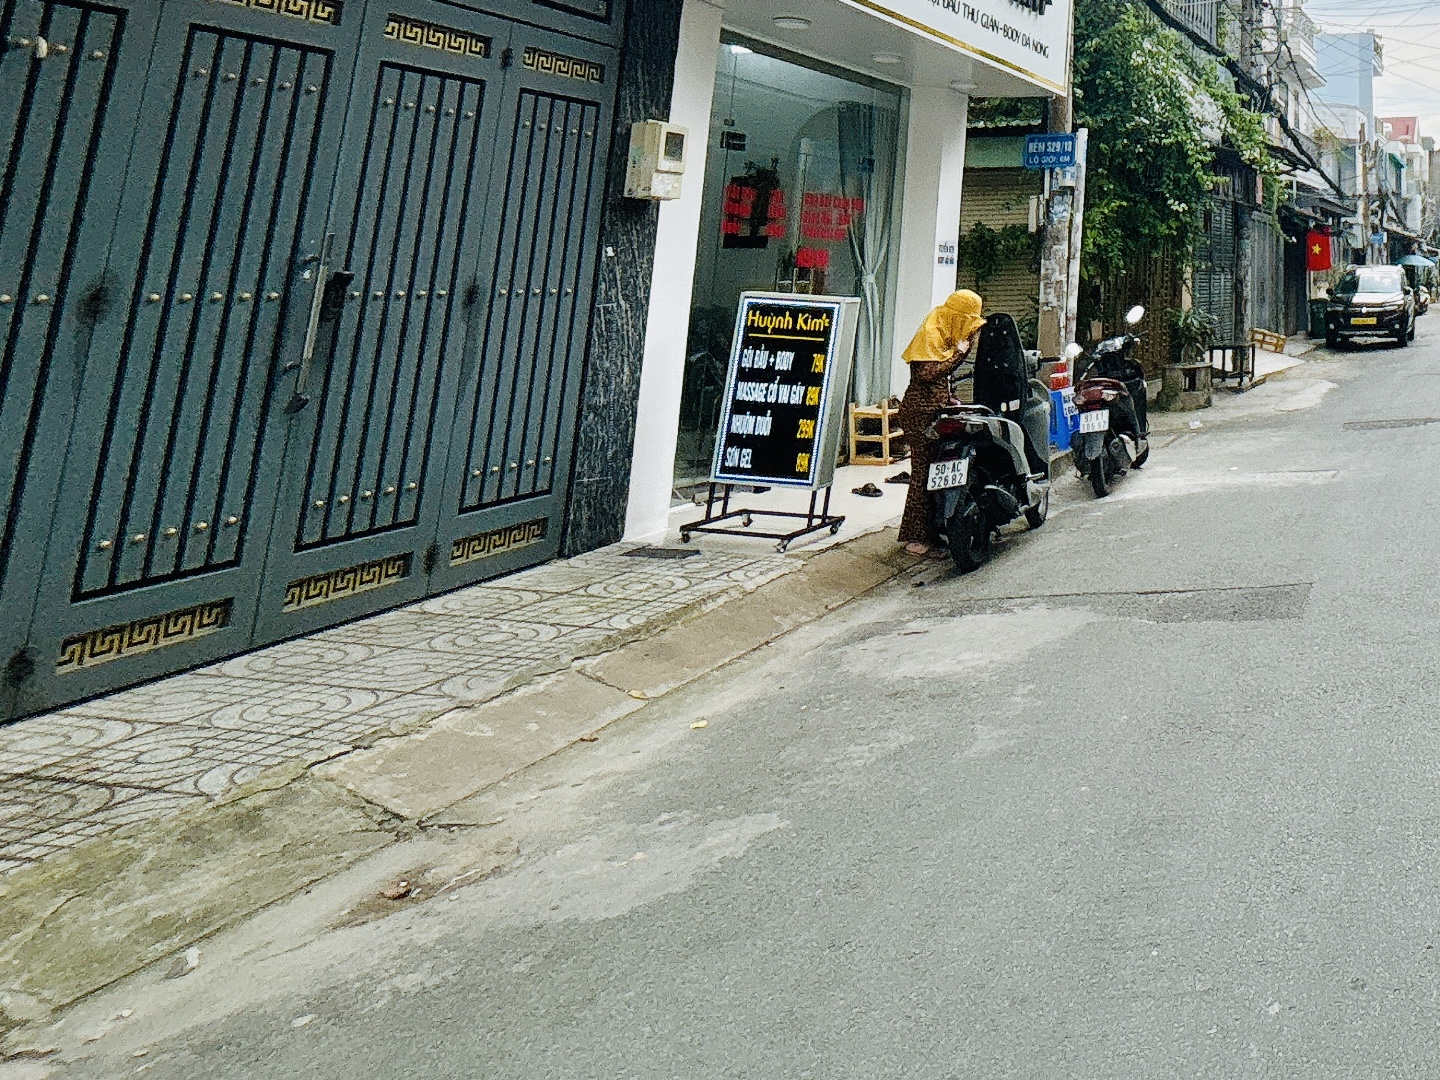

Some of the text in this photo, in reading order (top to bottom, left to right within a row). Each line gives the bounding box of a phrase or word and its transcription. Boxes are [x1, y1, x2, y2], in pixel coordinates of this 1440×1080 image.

[747, 309, 826, 335] Huỳnh Kim
[774, 350, 796, 371] BODY
[735, 381, 769, 403] MASSAGE
[739, 447, 753, 469] GEL
